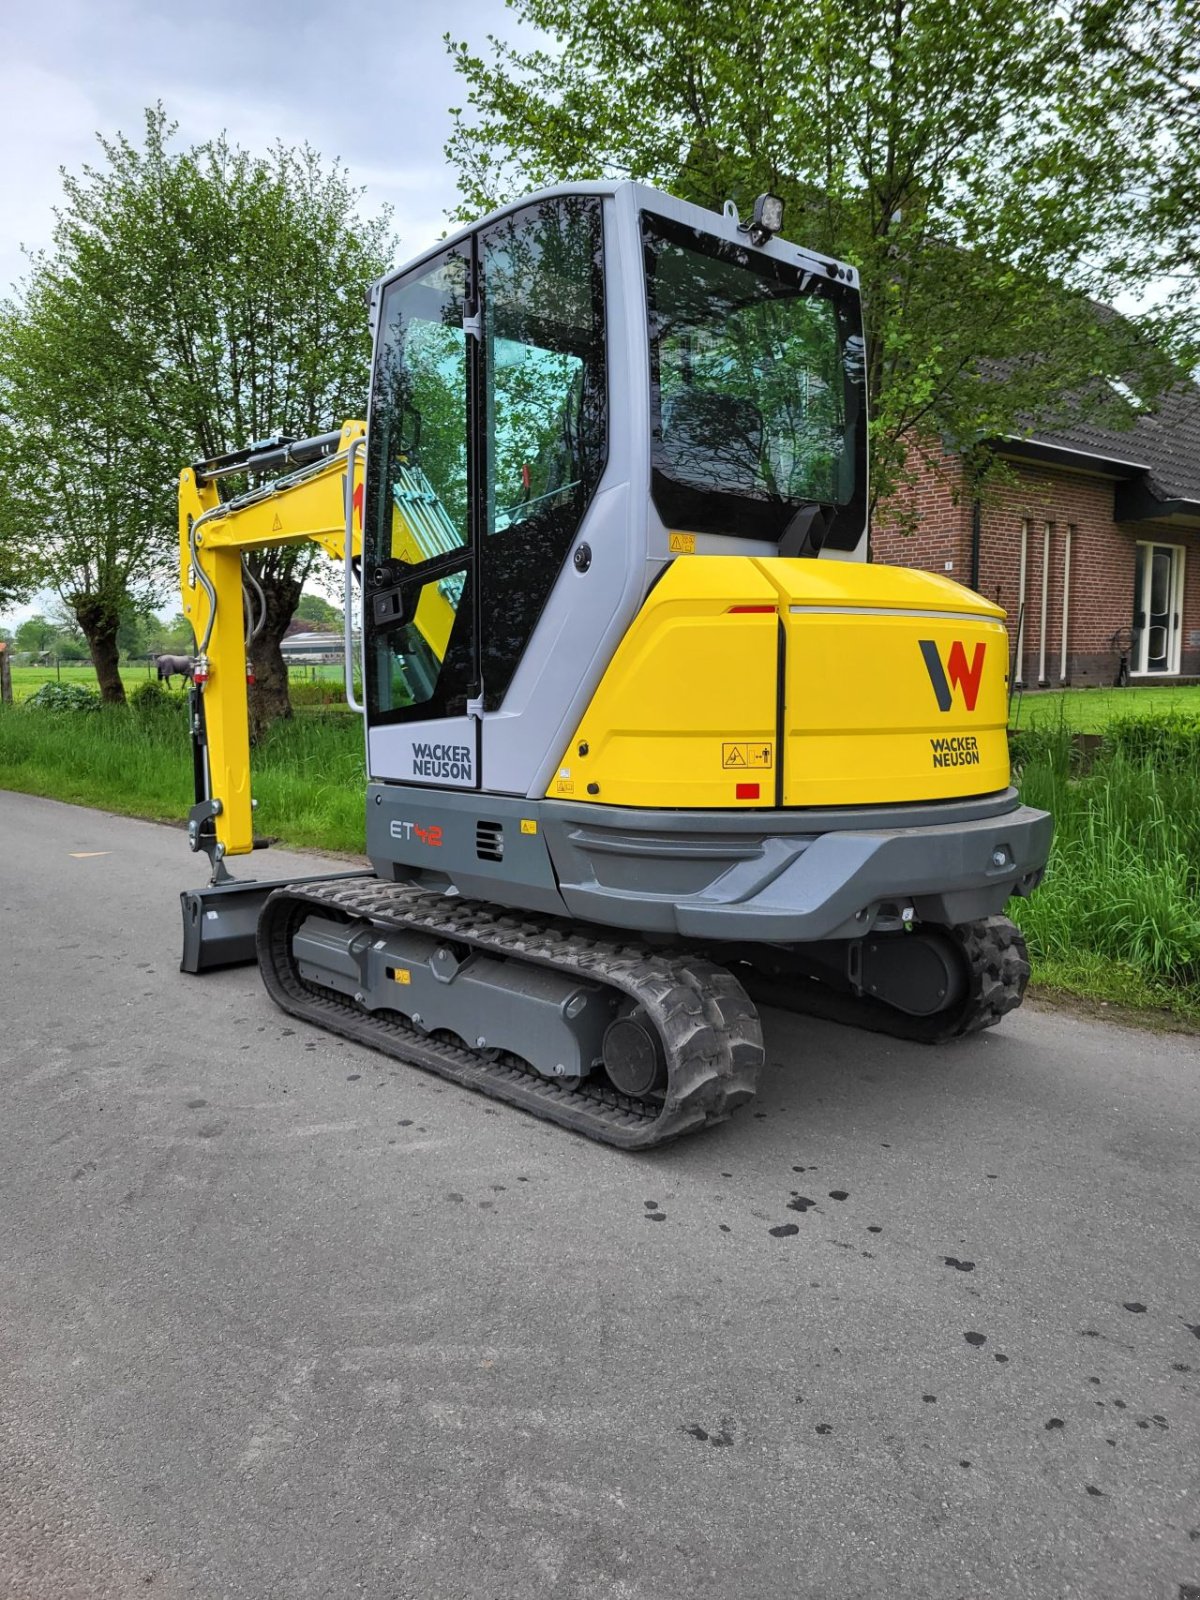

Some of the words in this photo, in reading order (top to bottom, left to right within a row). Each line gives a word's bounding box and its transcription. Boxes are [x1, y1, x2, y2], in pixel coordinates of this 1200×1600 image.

[412, 743, 471, 763] WACKER
[930, 736, 978, 753] WACKER
[413, 759, 472, 780] NEUSON
[933, 751, 980, 768] NEUSON
[390, 820, 444, 847] ET42
